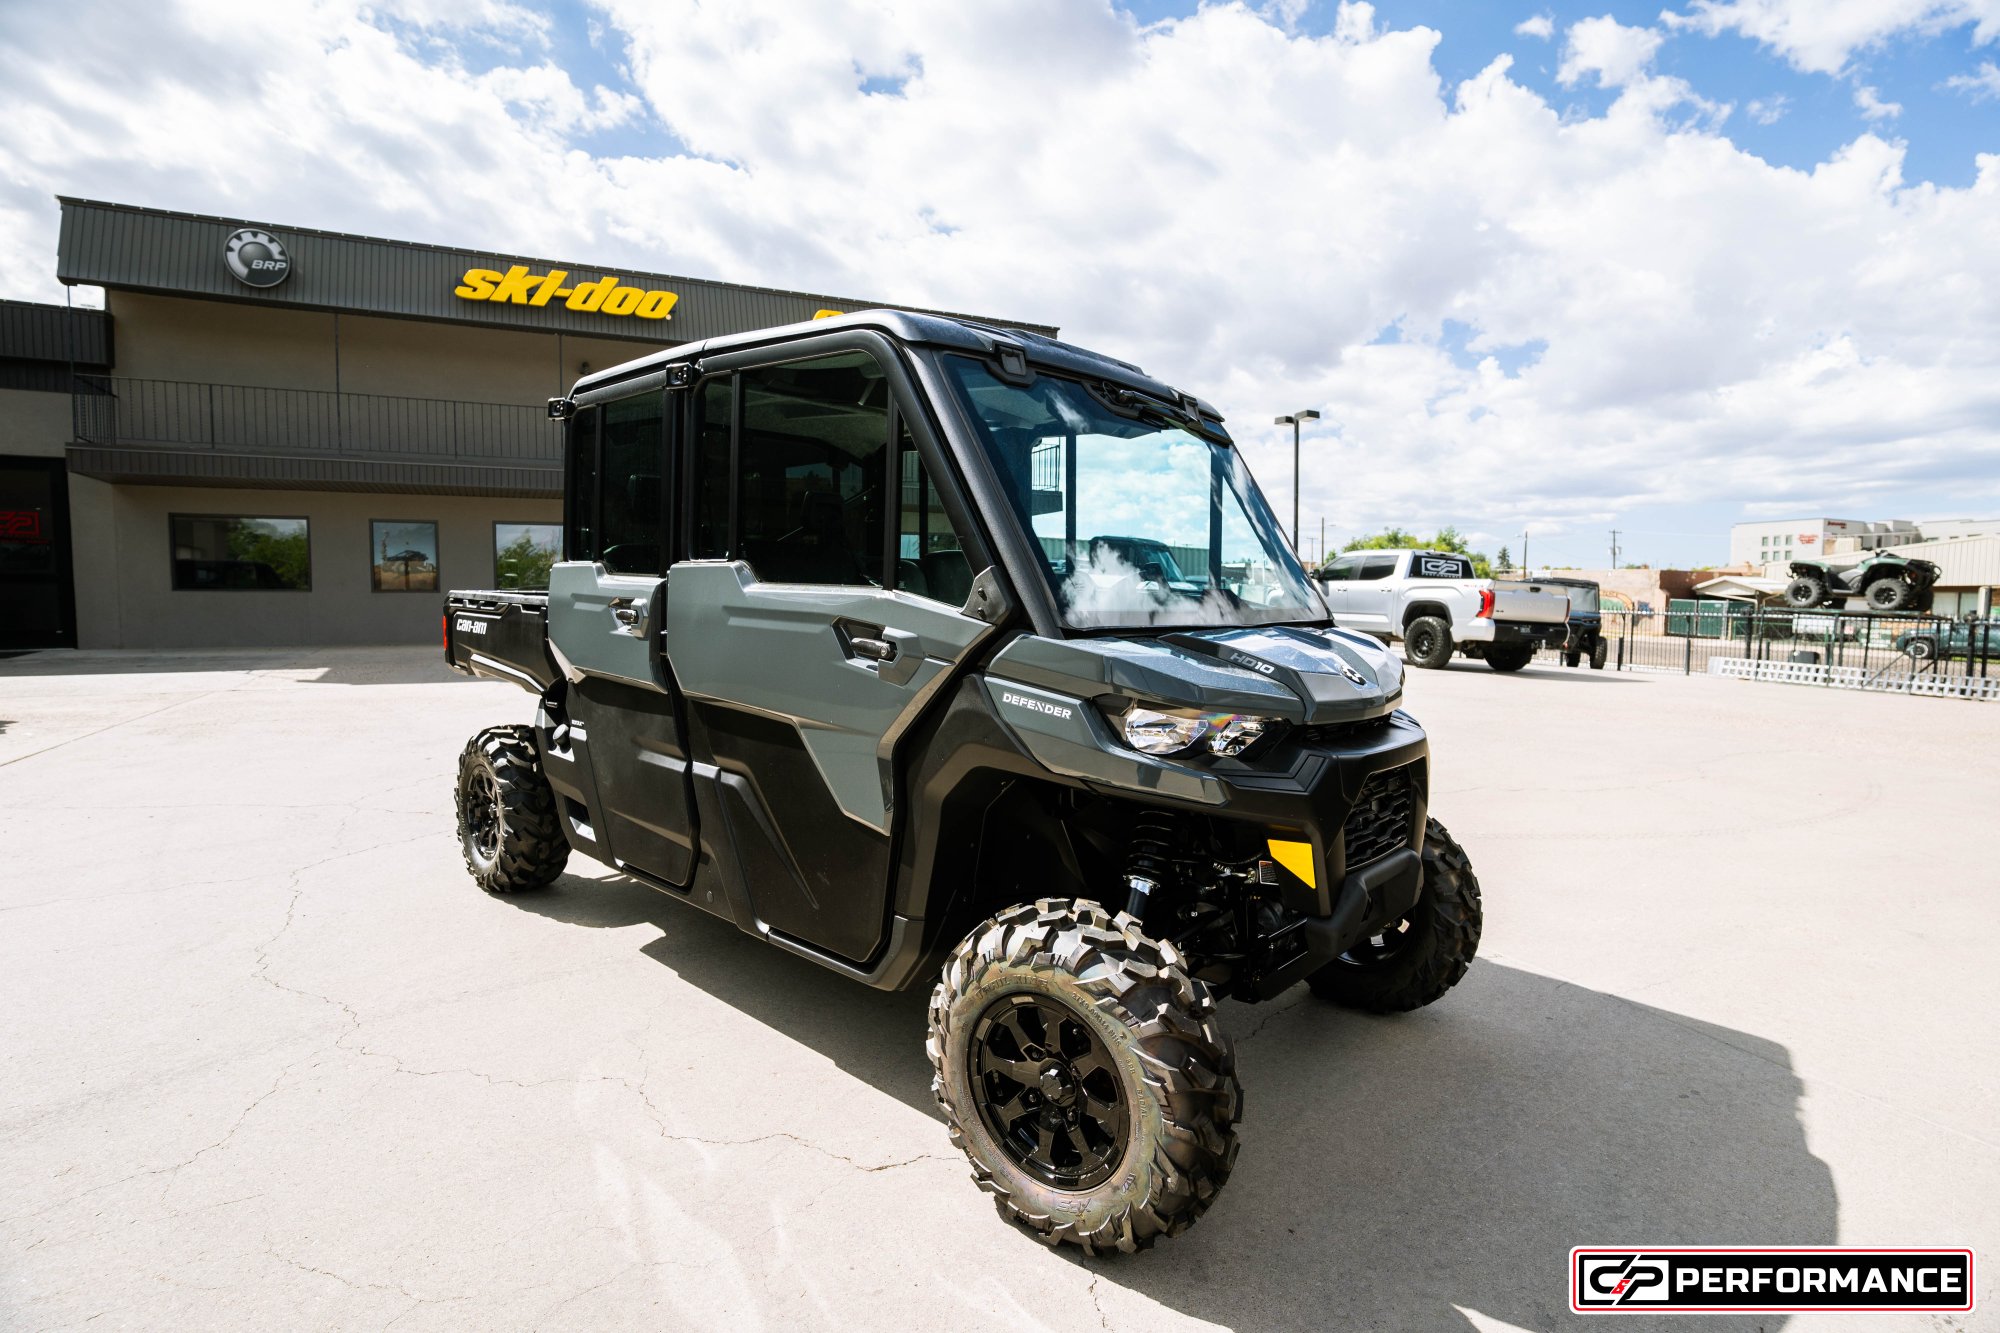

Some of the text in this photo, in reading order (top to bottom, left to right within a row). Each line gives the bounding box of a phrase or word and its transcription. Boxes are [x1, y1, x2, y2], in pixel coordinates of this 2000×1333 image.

[251, 260, 287, 271] BRP
[456, 618, 488, 635] can-am
[1230, 652, 1275, 674] HD10
[1002, 693, 1072, 719] DEFENDER
